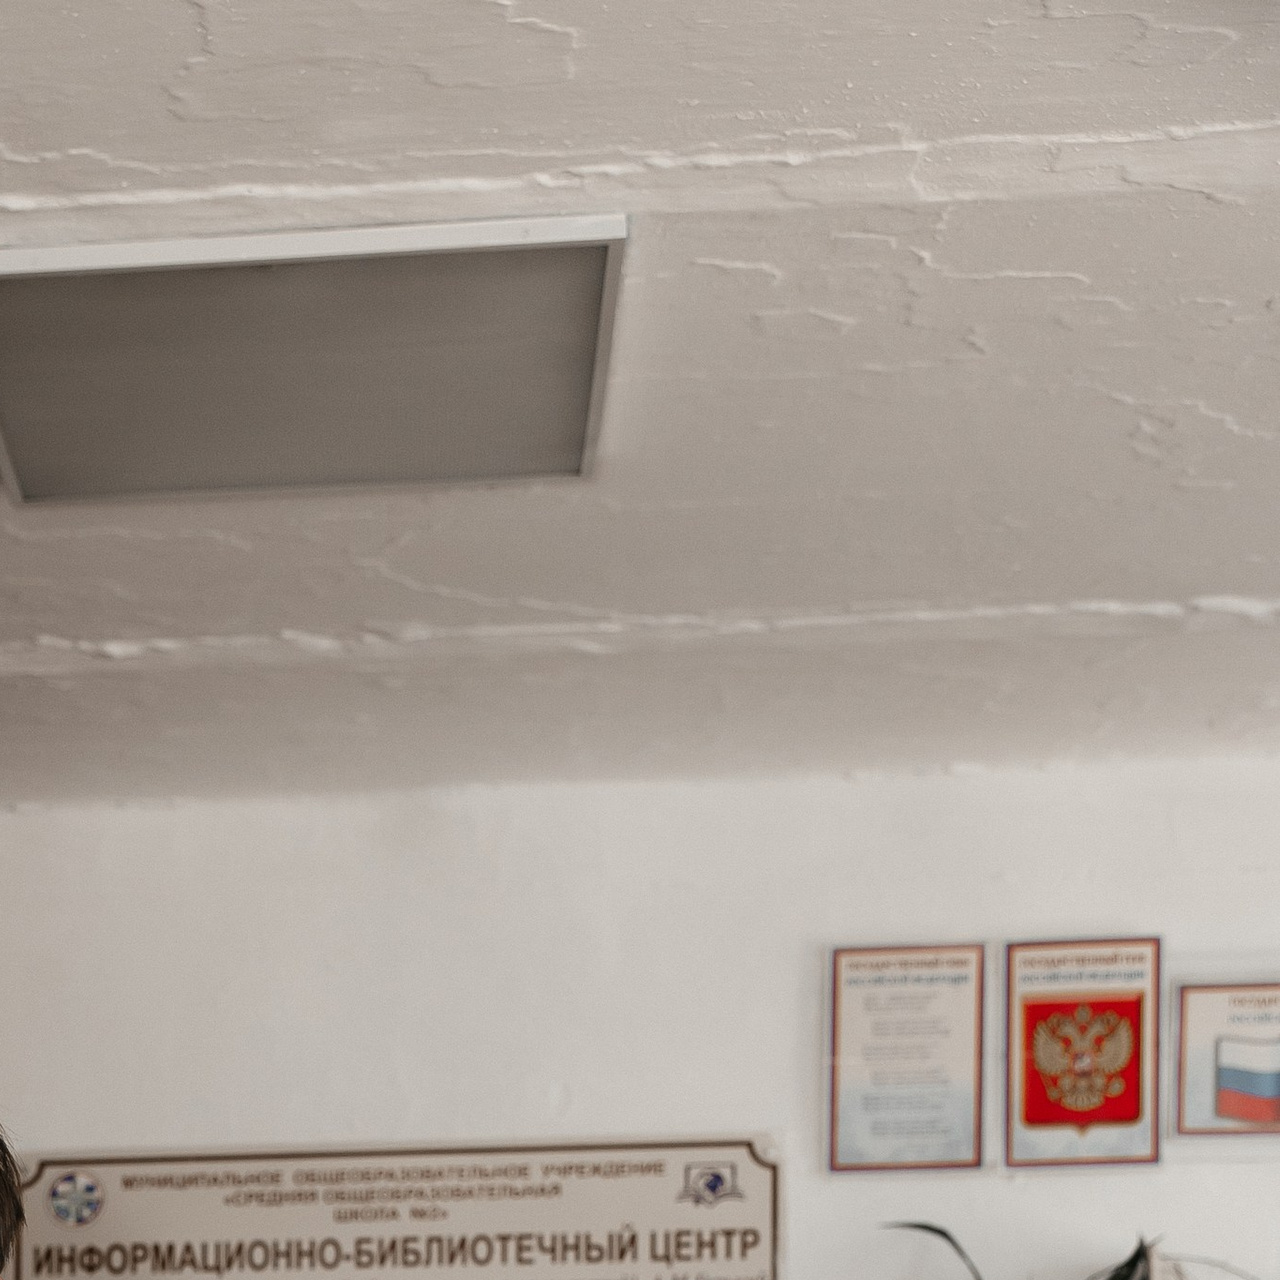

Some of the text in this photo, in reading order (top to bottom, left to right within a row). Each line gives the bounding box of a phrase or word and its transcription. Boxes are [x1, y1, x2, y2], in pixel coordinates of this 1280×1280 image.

[122, 1160, 666, 1190] МУНИЦИПАЛЬНОЕ ОБЩЕОБРАЗОВАТЕЛЬНОЕ УЧРЕЖДЕНИЕ
[322, 1183, 563, 1204] ОБЩЕОБРАЗОВАТЕЛЬНАЯ
[333, 1207, 400, 1222] ШКОЛА
[33, 1222, 761, 1278] ИНФОРМАЦИОННО-БИБЛИОТЕЧНЫЙ ЦЕНТР
